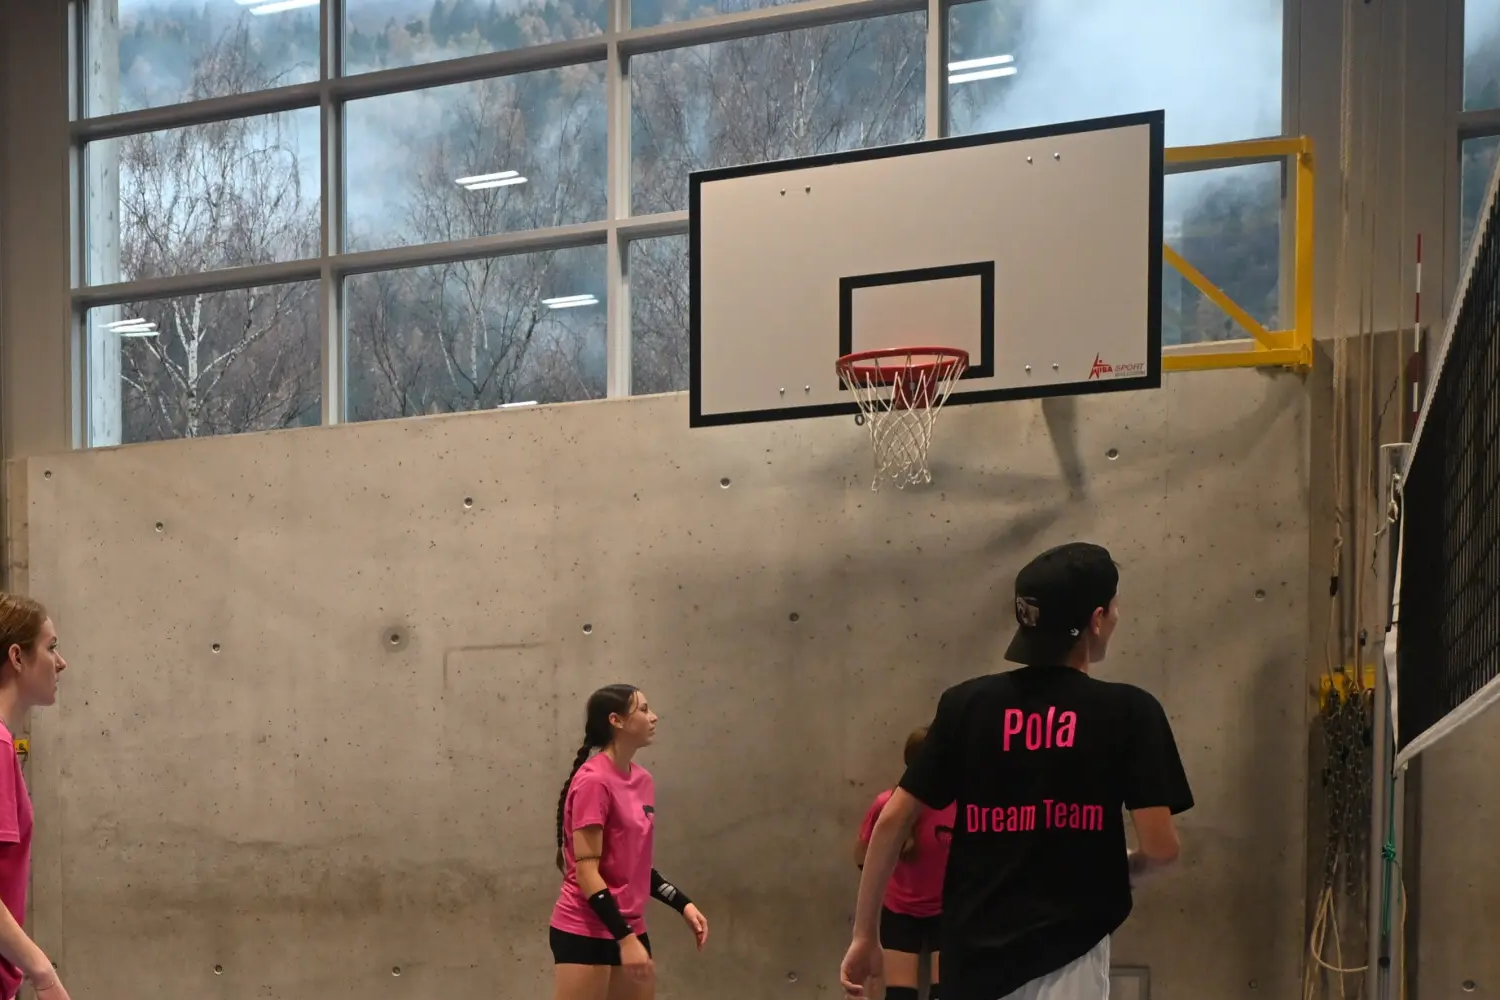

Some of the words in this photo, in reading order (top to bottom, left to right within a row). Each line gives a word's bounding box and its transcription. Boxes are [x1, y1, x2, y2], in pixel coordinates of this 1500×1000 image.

[1003, 706, 1077, 751] Pola
[966, 802, 1036, 833] Dream
[1043, 799, 1103, 831] Team
